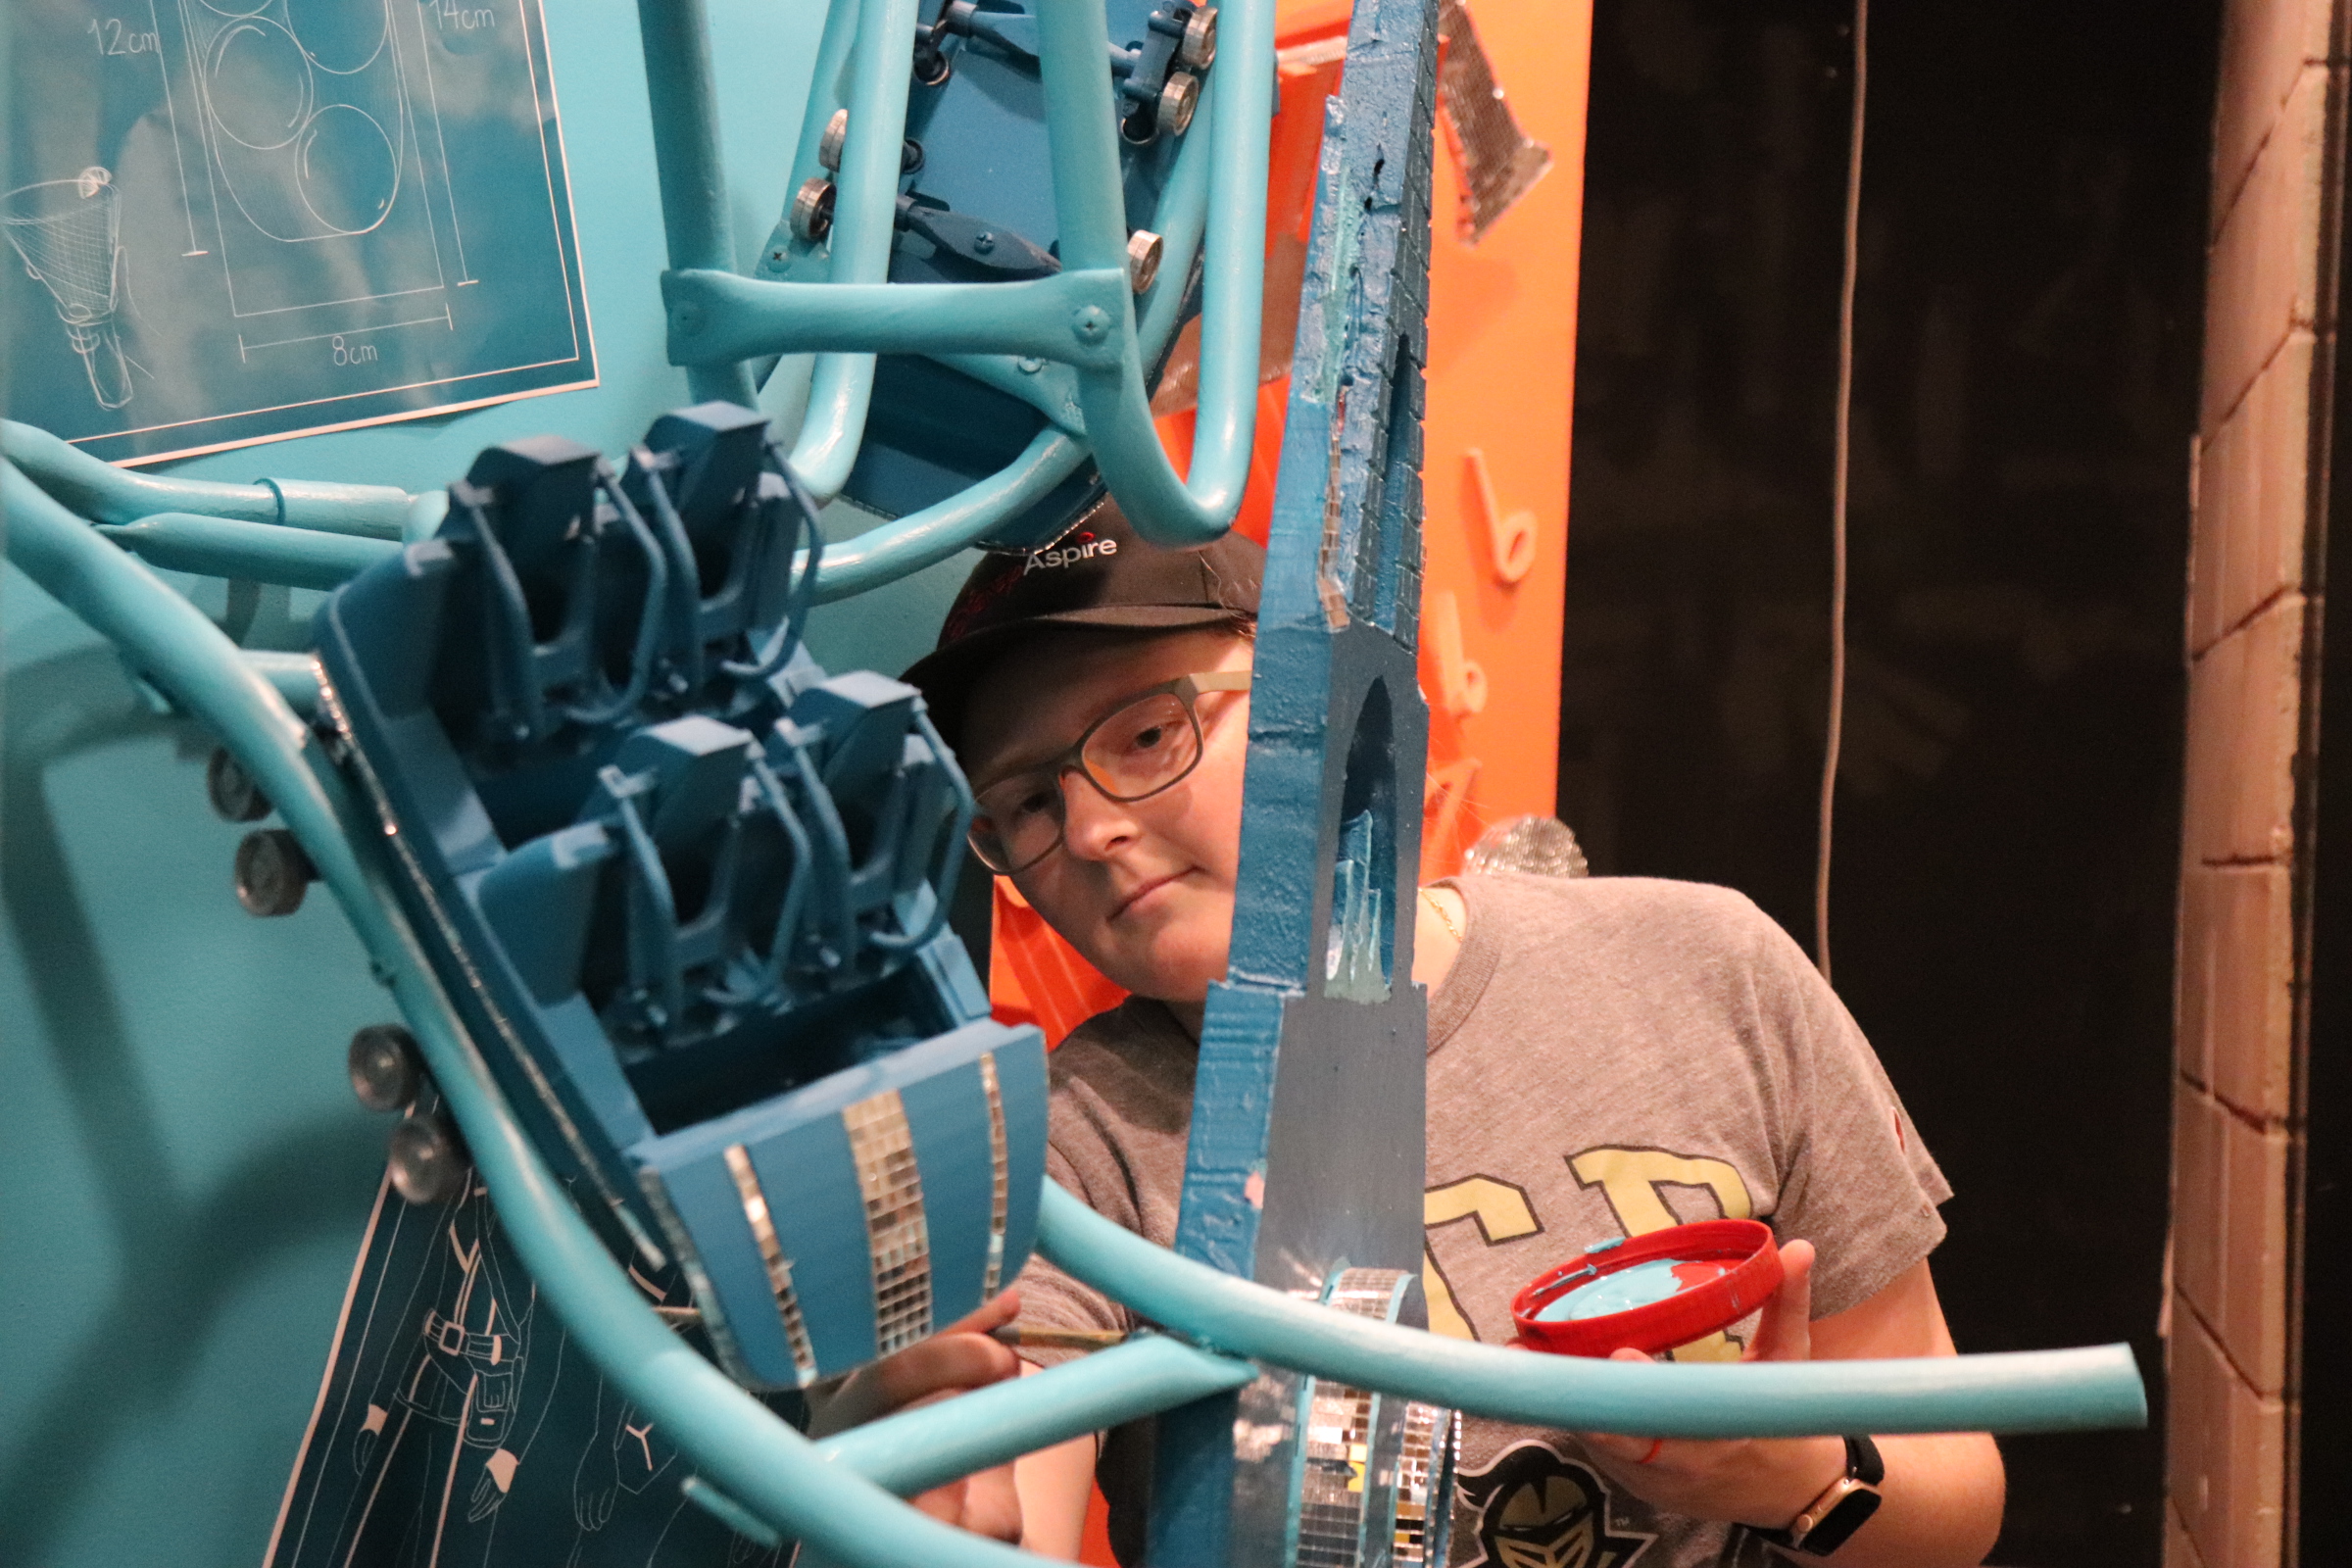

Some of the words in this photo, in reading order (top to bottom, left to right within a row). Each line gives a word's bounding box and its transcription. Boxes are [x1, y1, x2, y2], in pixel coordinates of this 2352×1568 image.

[87, 18, 160, 55] 12cm
[332, 335, 378, 366] 8cm
[1022, 531, 1117, 576] Aspire
